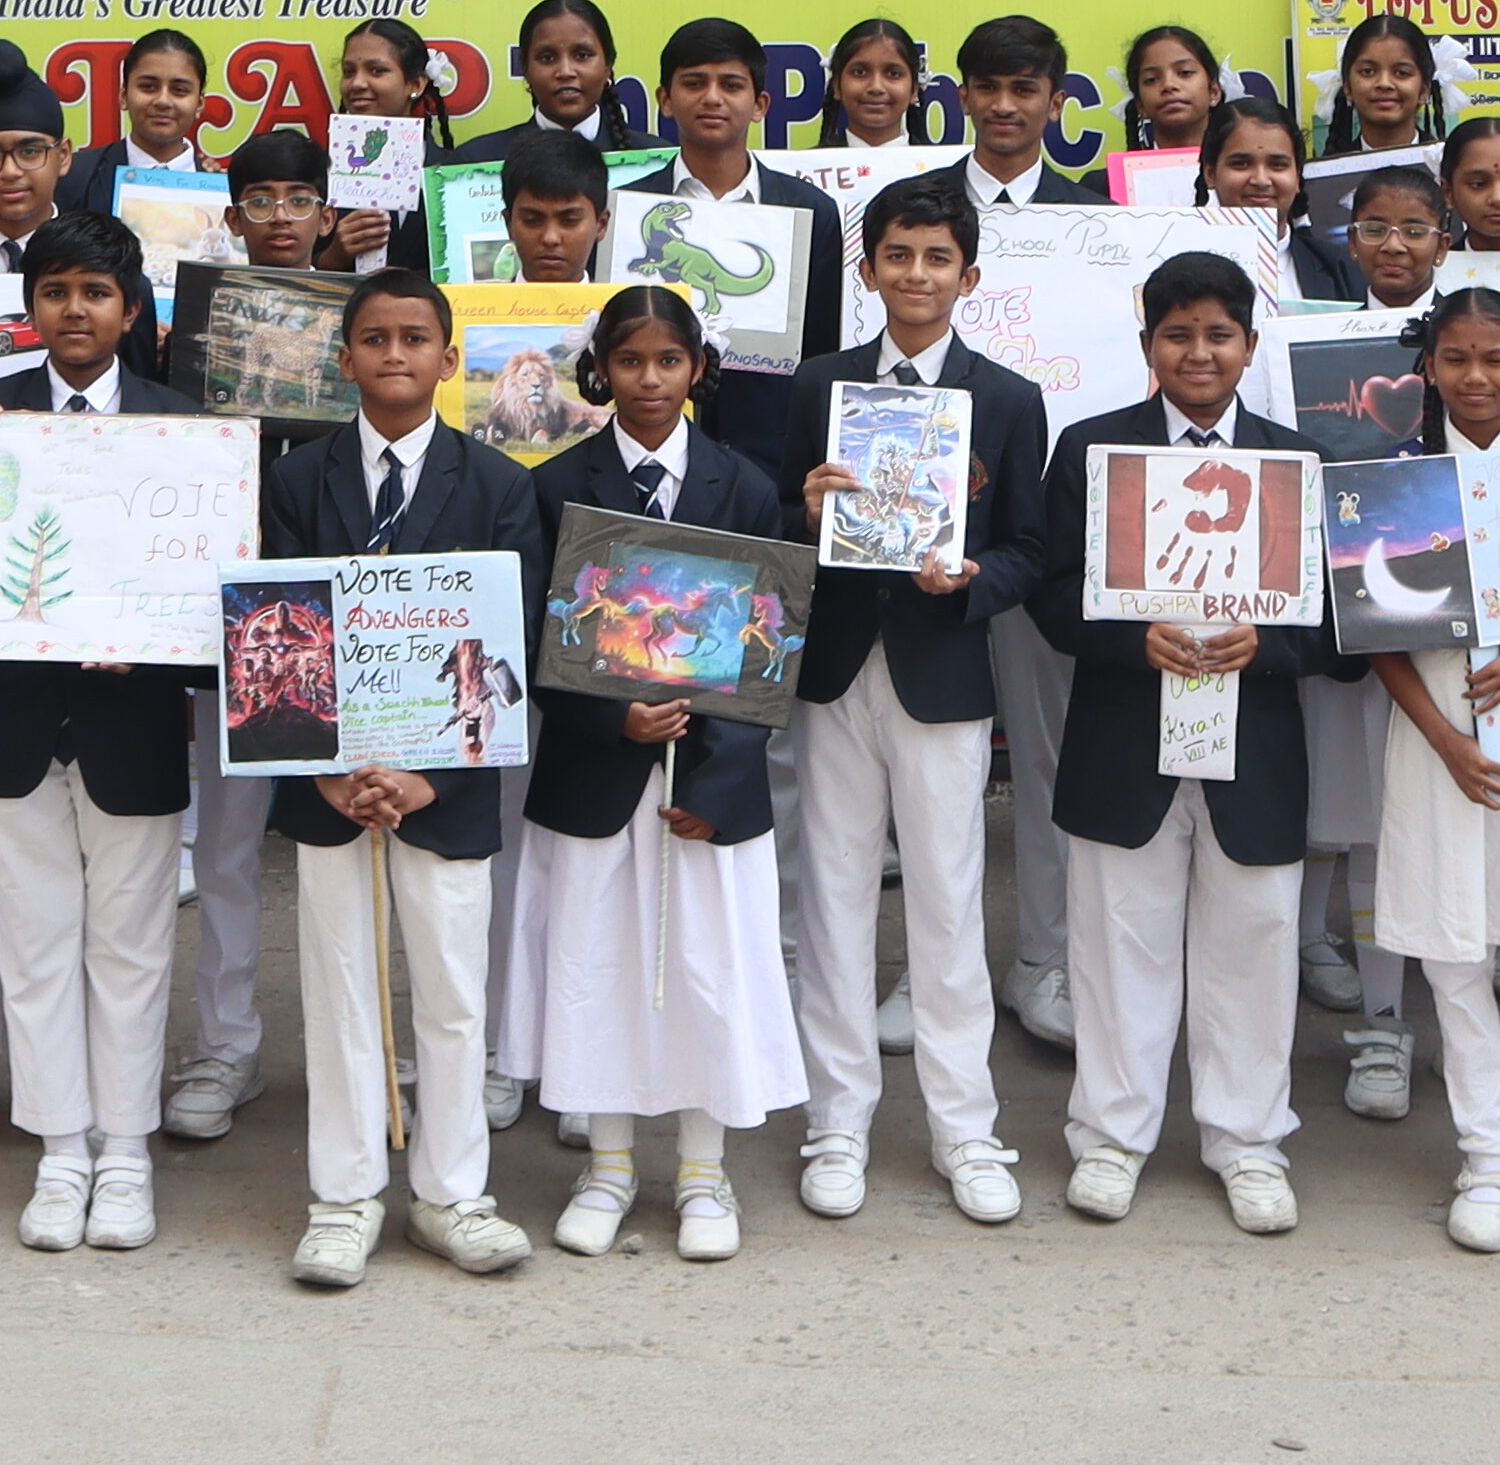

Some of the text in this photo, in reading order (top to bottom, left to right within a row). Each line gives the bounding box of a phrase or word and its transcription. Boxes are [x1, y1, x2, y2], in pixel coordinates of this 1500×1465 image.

[978, 215, 1057, 255] SCHOOL
[720, 353, 794, 373] INOSAUR
[120, 478, 233, 520] VOTE
[335, 559, 412, 595] VOTE
[344, 600, 469, 631] AVENGERS
[1119, 592, 1289, 622] PUSHPA BRAND
[340, 633, 401, 664] VOTE
[1162, 712, 1227, 745] Kiran
